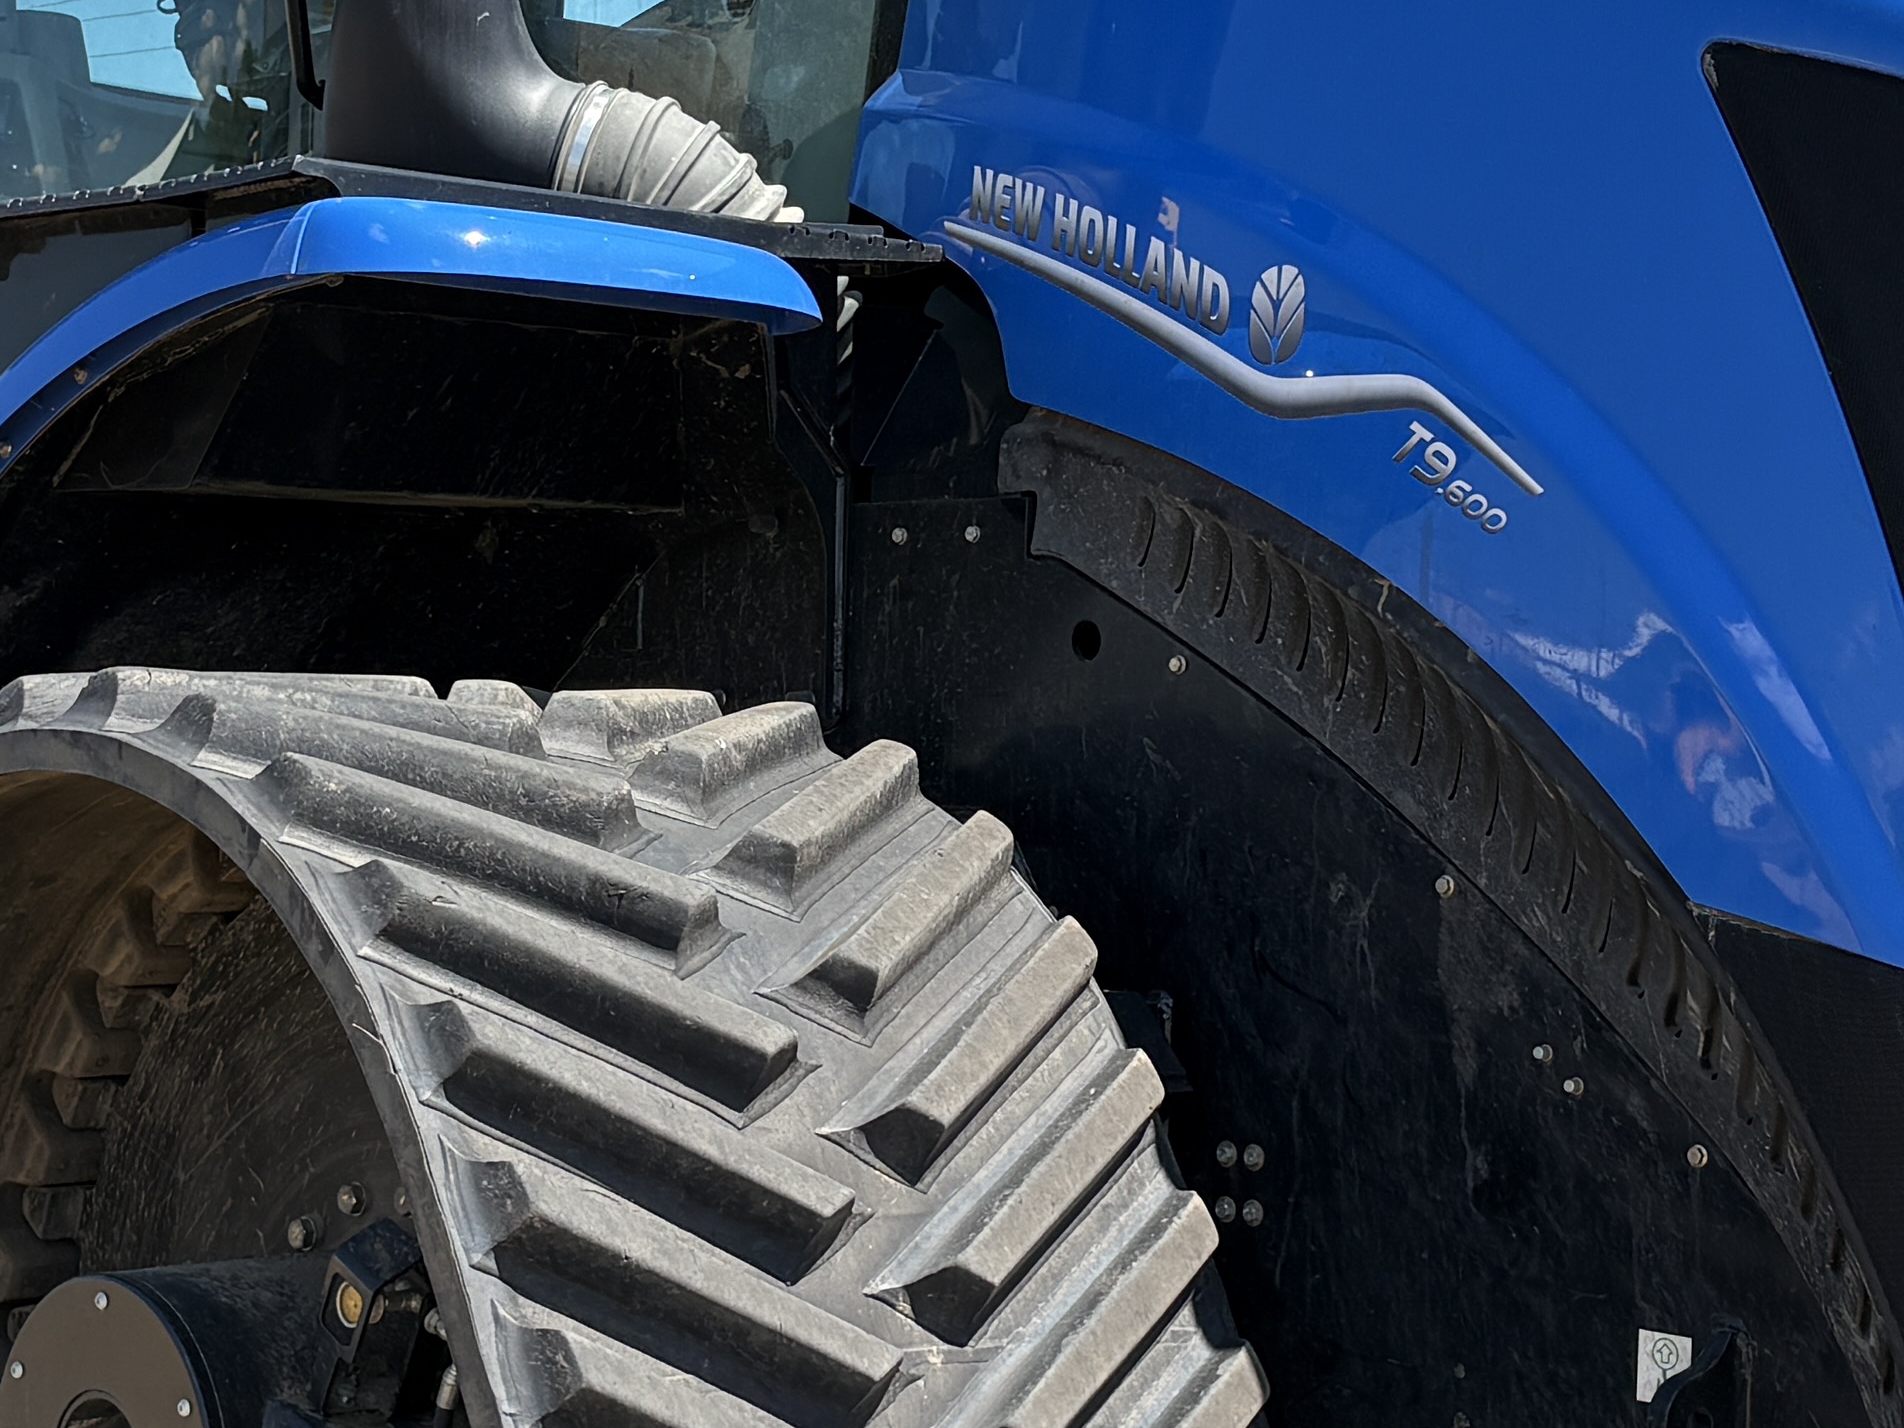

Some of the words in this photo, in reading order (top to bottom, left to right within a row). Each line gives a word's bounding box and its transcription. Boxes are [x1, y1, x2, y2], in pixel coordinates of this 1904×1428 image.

[969, 165, 1045, 241] NEW
[1052, 192, 1230, 336] HOLLAND
[1392, 420, 1507, 534] T9.600
